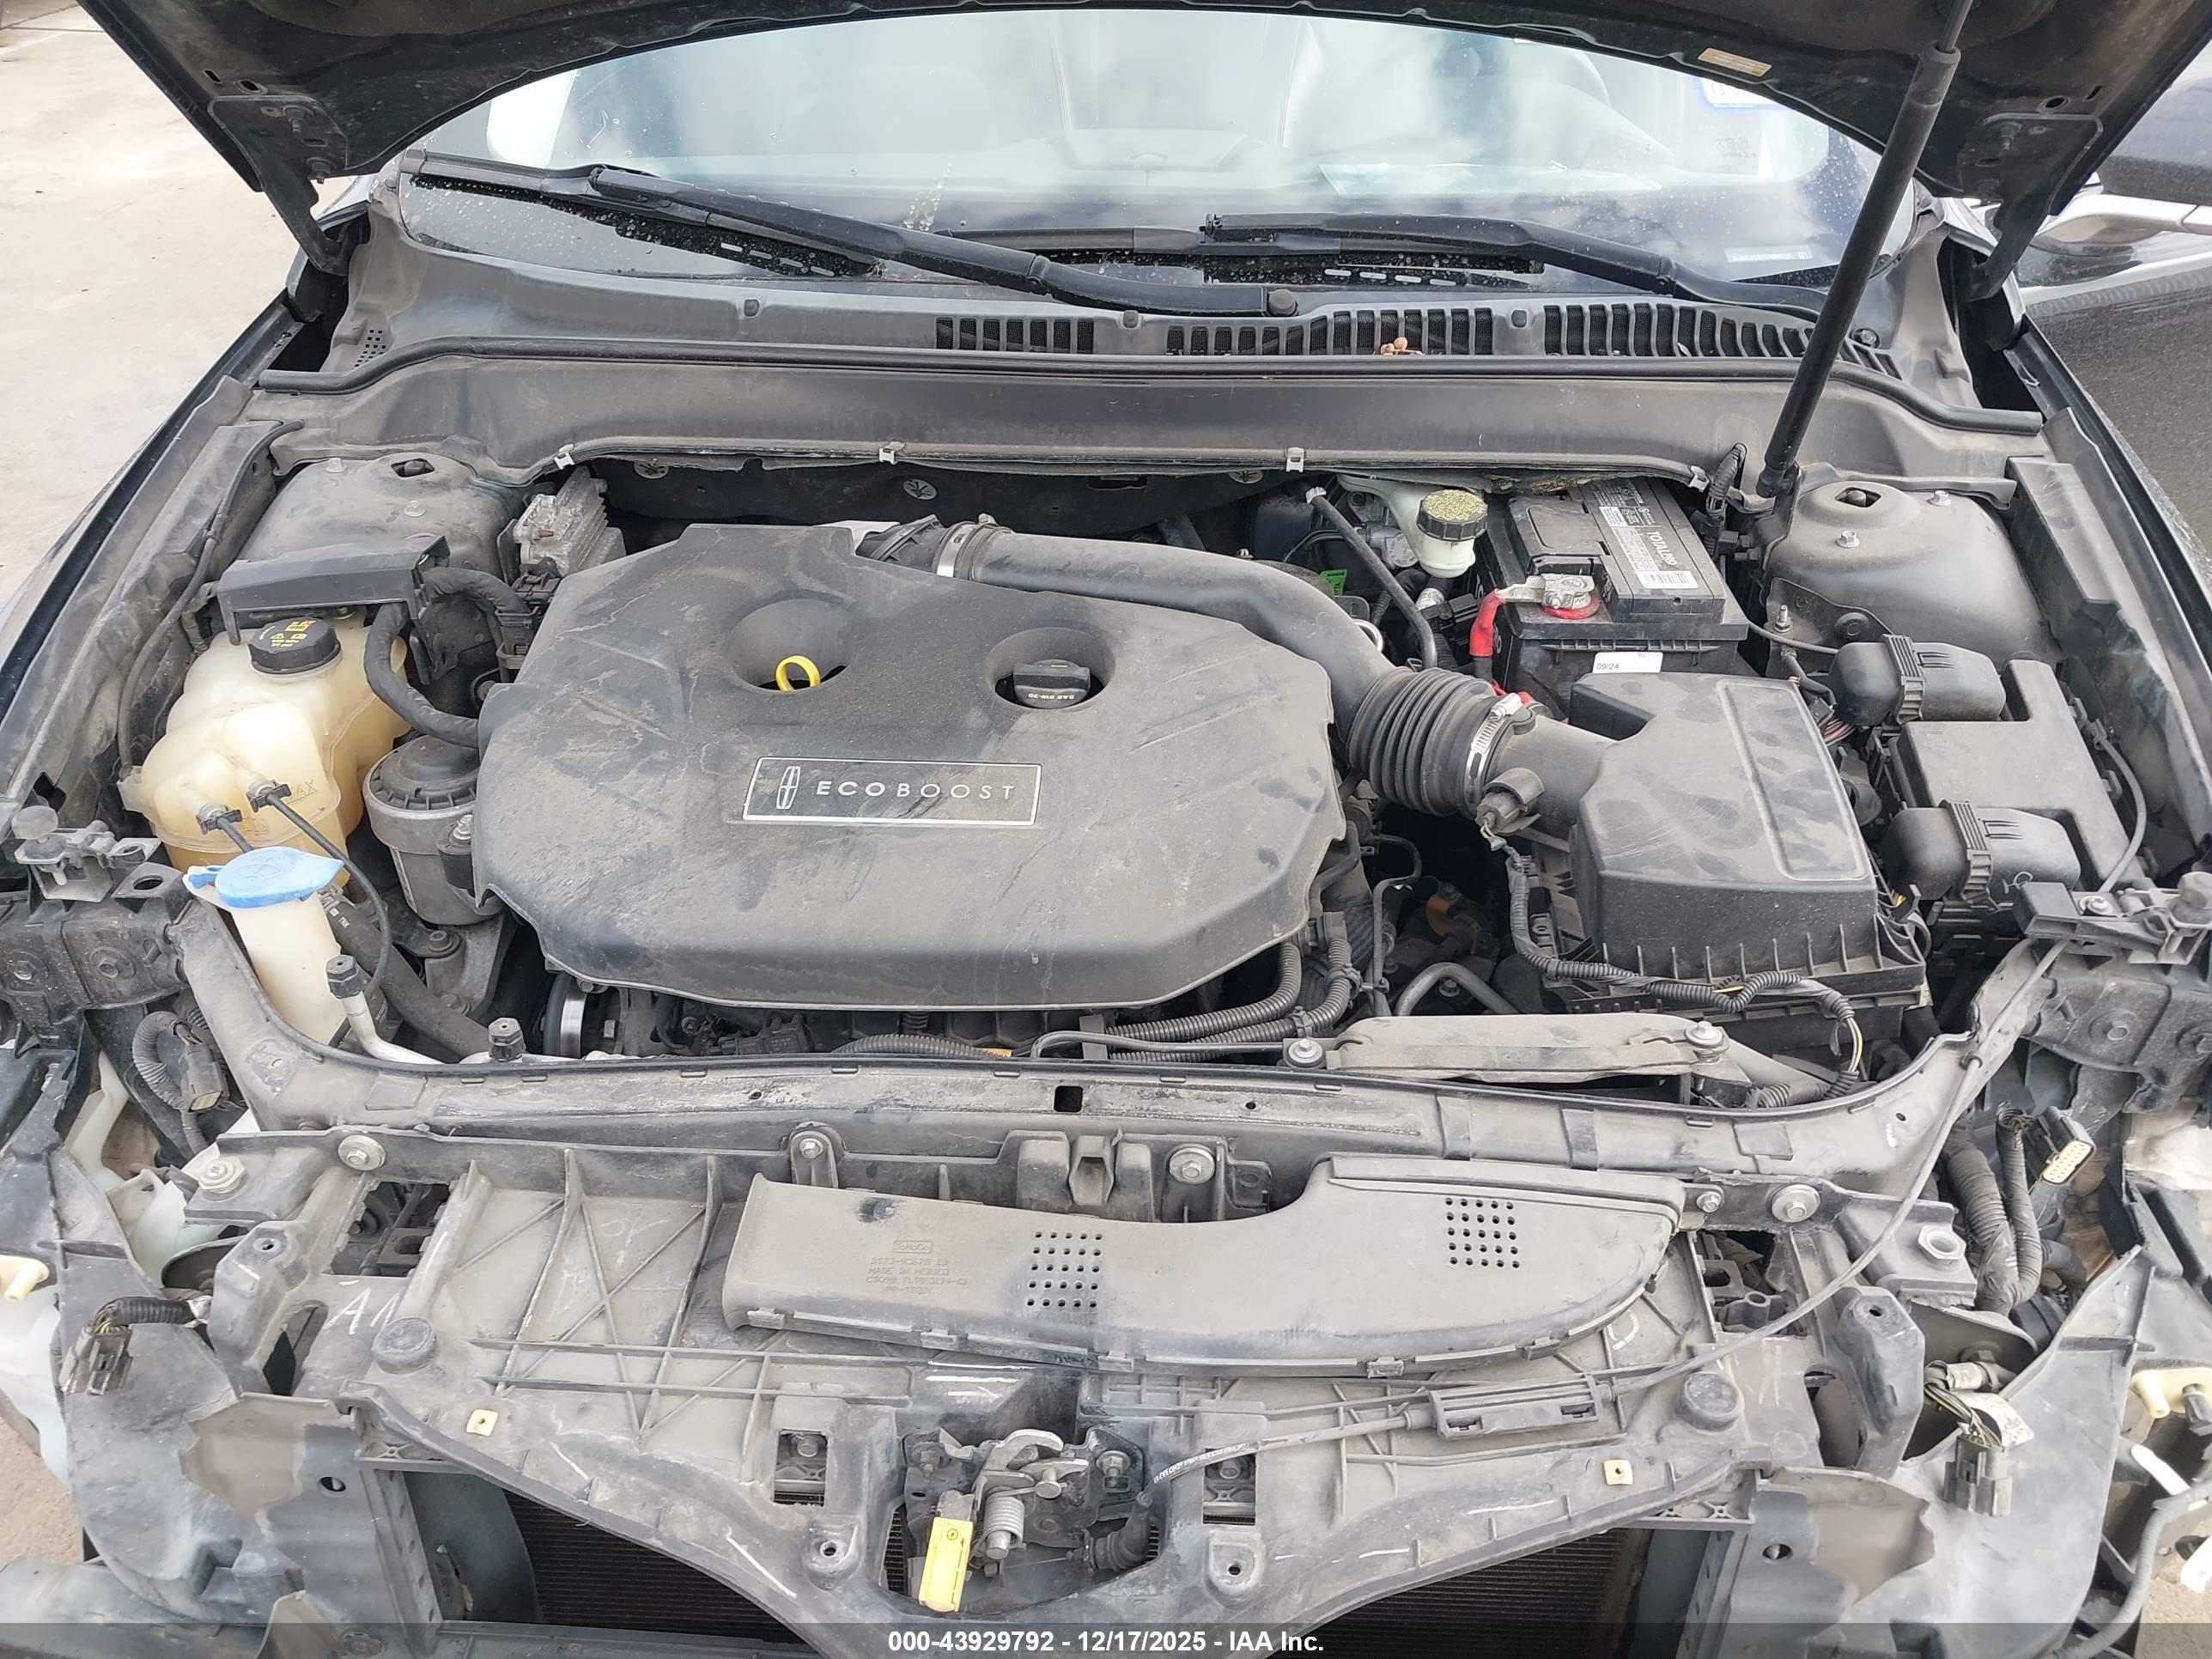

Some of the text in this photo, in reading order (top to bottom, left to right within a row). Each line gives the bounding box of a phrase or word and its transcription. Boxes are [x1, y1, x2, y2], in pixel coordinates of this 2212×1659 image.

[1646, 531, 1678, 566] TOTALPRO
[1596, 662, 1620, 671] 09/24
[817, 781, 1014, 799] ECOBOOST
